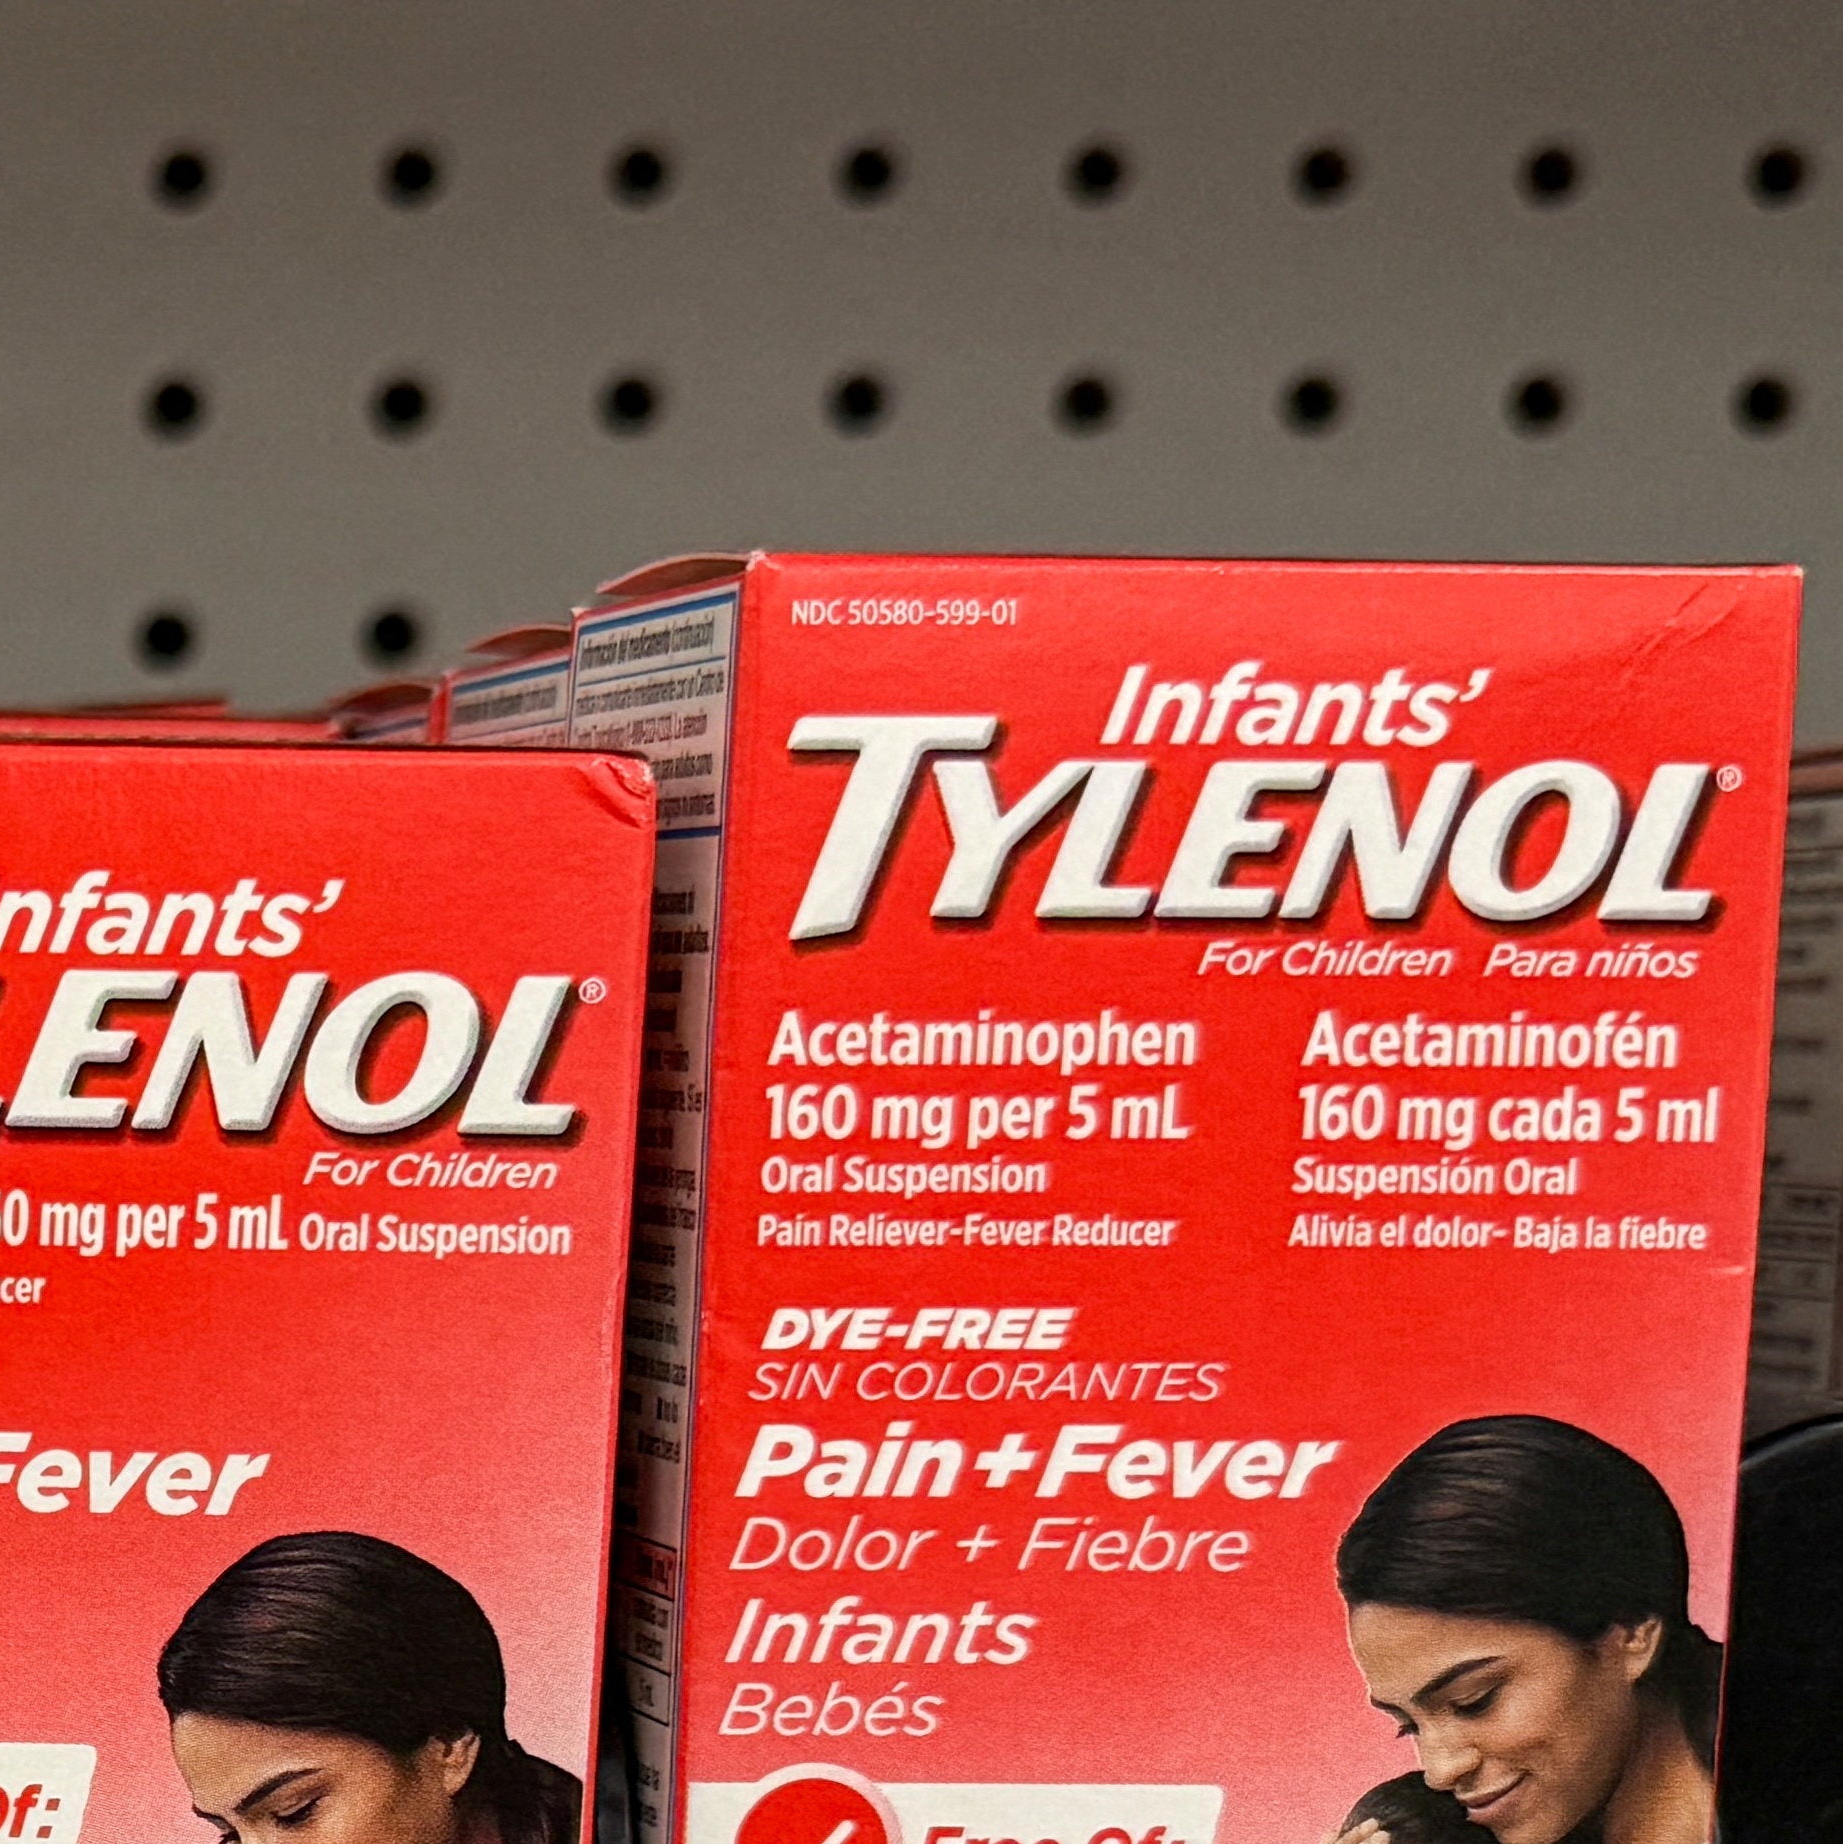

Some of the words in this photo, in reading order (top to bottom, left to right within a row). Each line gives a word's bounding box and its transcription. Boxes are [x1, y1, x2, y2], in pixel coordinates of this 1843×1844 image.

[790, 598, 841, 628] NDC
[848, 598, 1017, 627] 50580-599-01
[1197, 940, 1275, 976] For
[1283, 941, 1453, 977] Children
[1483, 943, 1578, 977] Para
[1586, 941, 1697, 979] niños
[767, 1010, 1197, 1078] Acetaminophen
[1302, 1009, 1678, 1070] Acetaminofén
[765, 1084, 857, 1140] 160
[871, 1096, 954, 1150] mg
[968, 1097, 1053, 1150] per
[1066, 1084, 1098, 1140] 5
[1111, 1085, 1189, 1140] mL
[1299, 1085, 1386, 1141] 160
[1396, 1098, 1475, 1151] mg
[1488, 1086, 1602, 1142] cada
[1614, 1086, 1646, 1143] 5
[762, 1155, 834, 1192] Oral
[843, 1155, 1046, 1199] Suspension
[1292, 1155, 1496, 1200] Suspensión
[1504, 1157, 1577, 1195] Oral
[758, 1213, 821, 1246] Pain
[829, 1213, 1046, 1247] Reliever-Fever
[1052, 1213, 1175, 1247] Reducer
[1287, 1213, 1373, 1247] Alivia
[1379, 1214, 1405, 1247] el
[1515, 1215, 1577, 1254] Baja
[1585, 1215, 1613, 1249] la
[1619, 1215, 1708, 1249] fiebre
[761, 1307, 1076, 1351] DYE-FREE
[749, 1362, 839, 1401] SIN
[857, 1362, 1227, 1402] COLORANTES
[729, 1515, 934, 1573] Dolor
[1017, 1515, 1251, 1573] Fiebre
[724, 1595, 1038, 1665] Infants
[717, 1680, 944, 1737] Bebés
